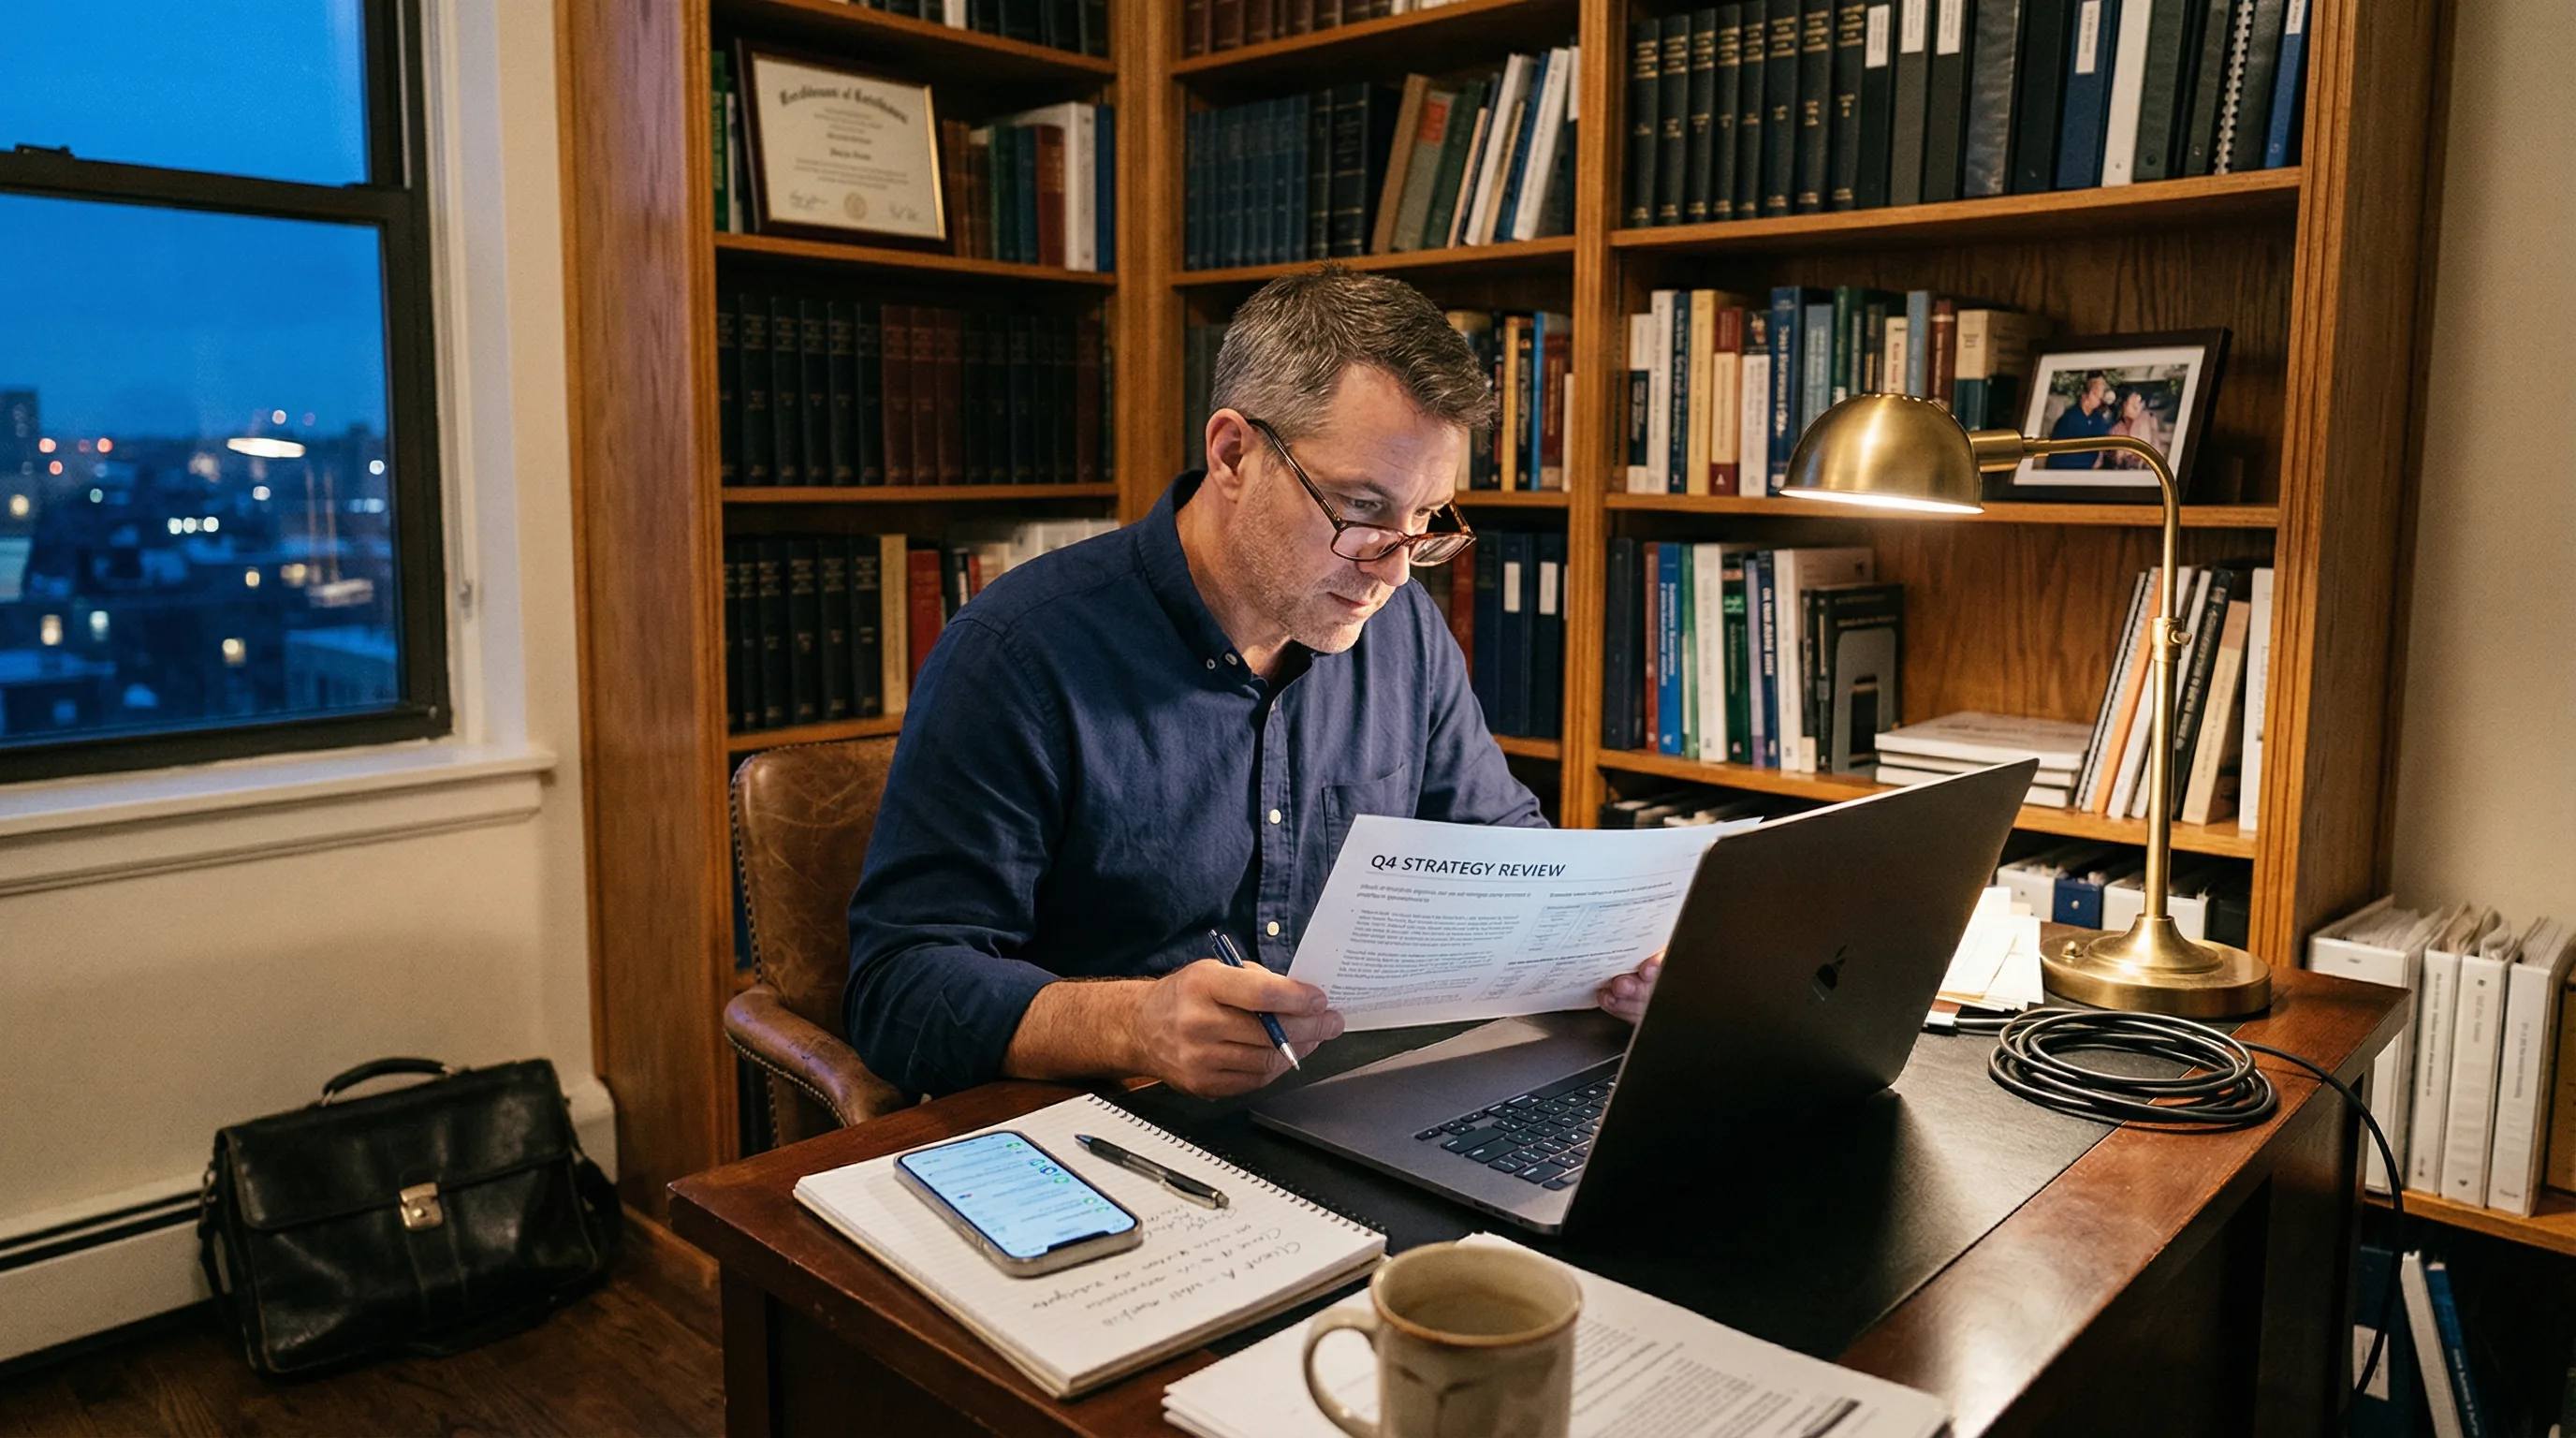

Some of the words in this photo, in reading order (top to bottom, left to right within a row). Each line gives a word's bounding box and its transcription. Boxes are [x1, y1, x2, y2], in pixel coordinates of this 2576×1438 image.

[1370, 854, 1398, 871] Q4
[1401, 857, 1496, 876] STRATEGY
[1498, 863, 1567, 877] REVIEW
